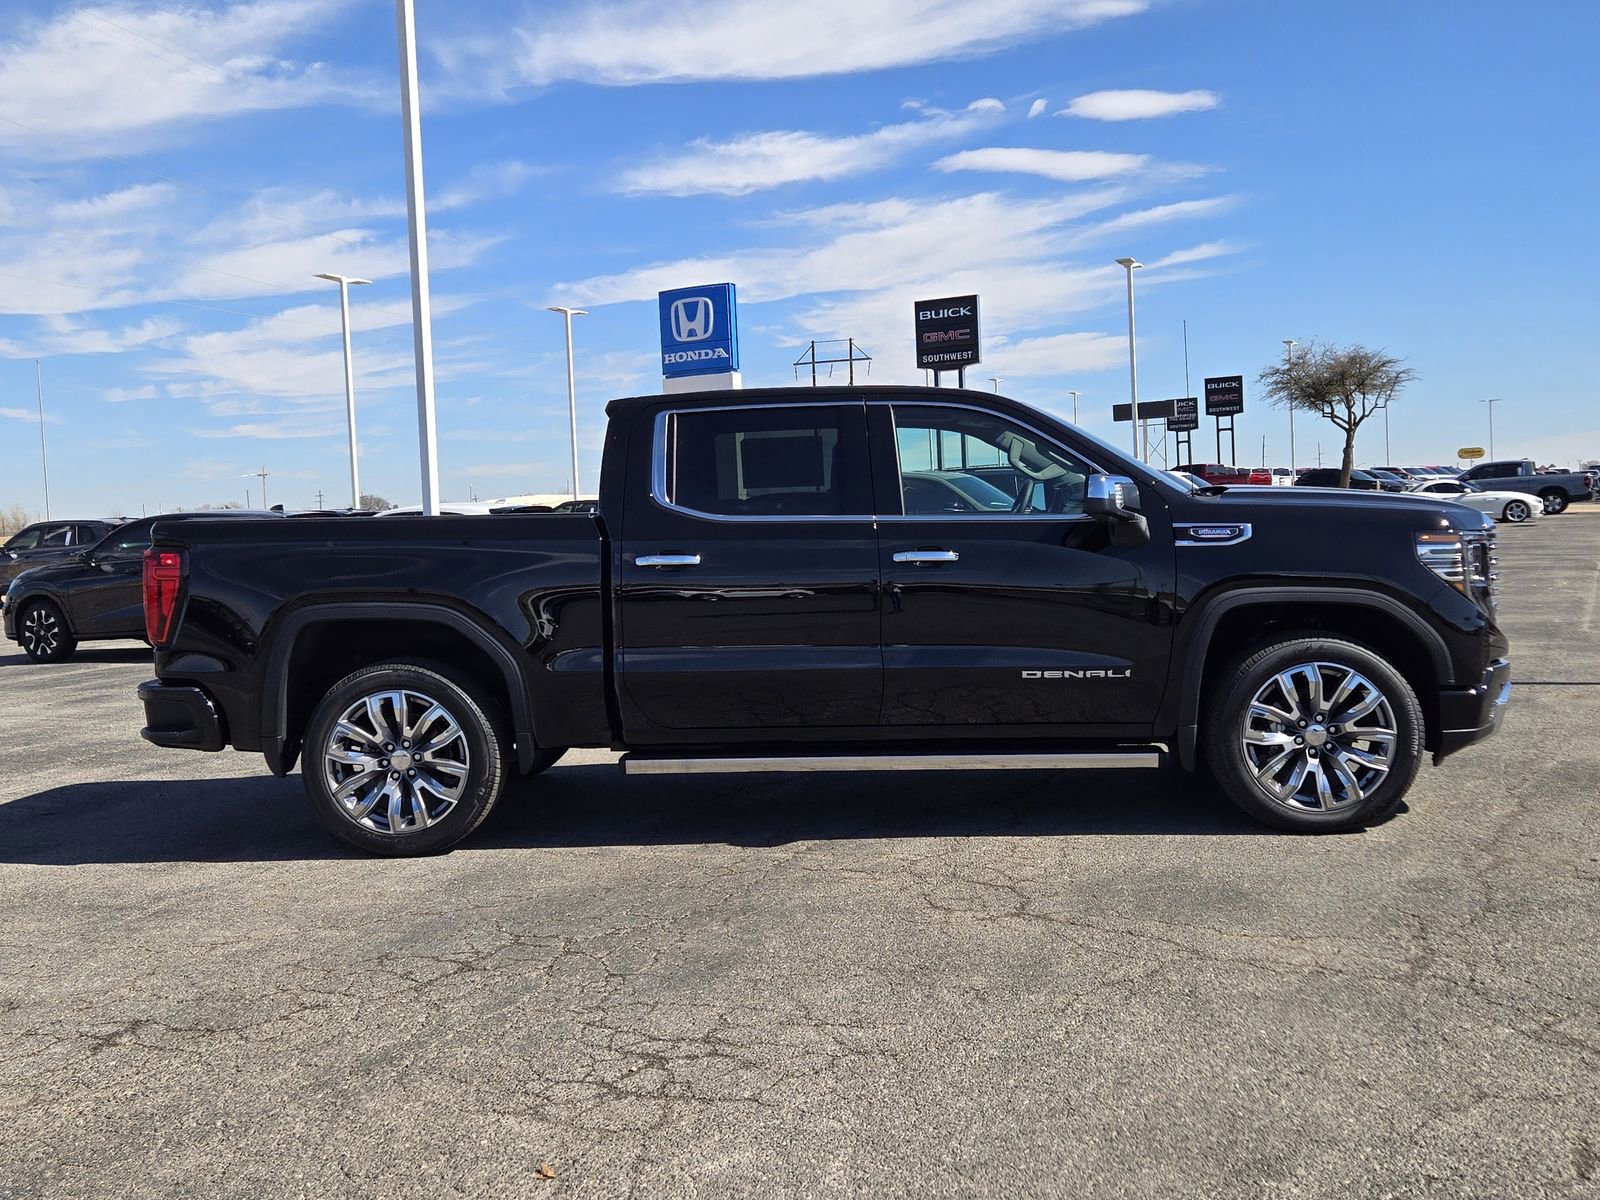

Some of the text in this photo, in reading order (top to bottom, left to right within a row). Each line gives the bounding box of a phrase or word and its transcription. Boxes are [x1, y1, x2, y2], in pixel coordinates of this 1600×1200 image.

[919, 306, 972, 320] BUICK
[923, 329, 970, 343] GMC
[663, 347, 729, 364] HONDA
[922, 351, 973, 363] SOUTHWEST
[1207, 381, 1239, 389] BUICK
[1208, 405, 1240, 413] SOUTHWEST
[1021, 669, 1131, 679] DENALI
